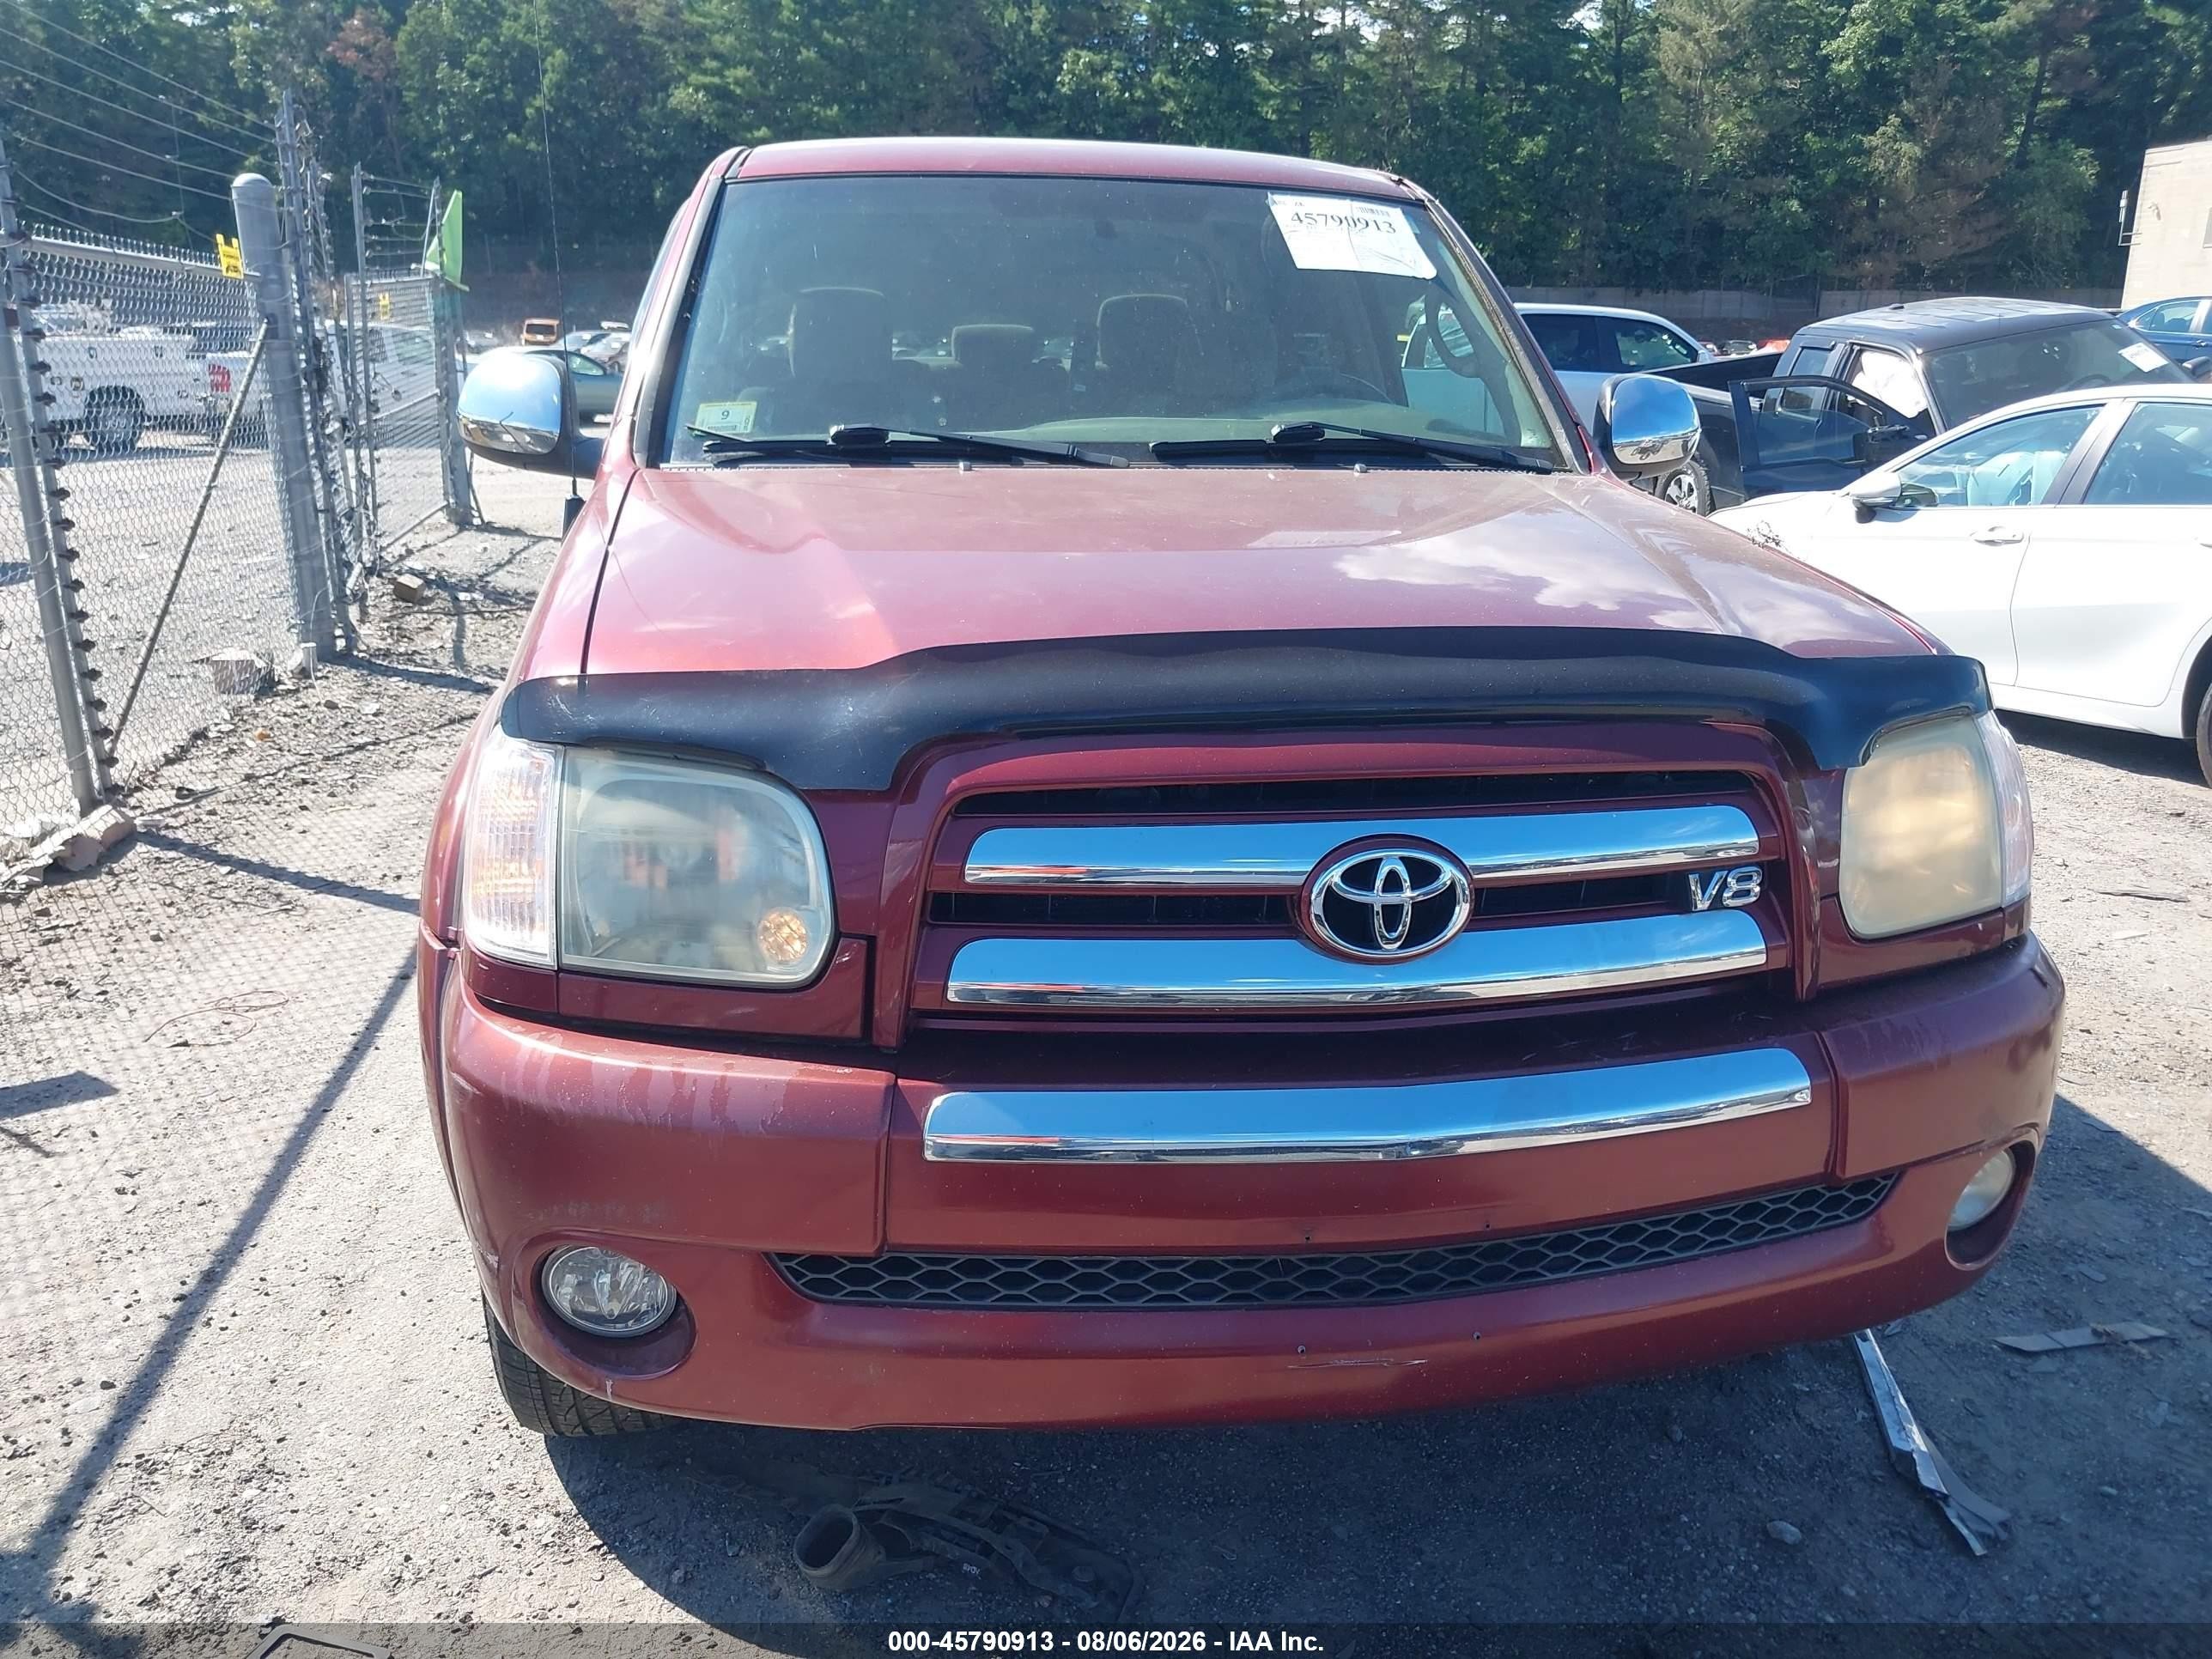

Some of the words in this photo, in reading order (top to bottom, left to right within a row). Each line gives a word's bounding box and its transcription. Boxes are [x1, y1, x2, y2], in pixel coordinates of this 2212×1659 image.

[1291, 211, 1396, 234] 45790913
[721, 410, 730, 420] 9
[1688, 866, 1763, 912] V8
